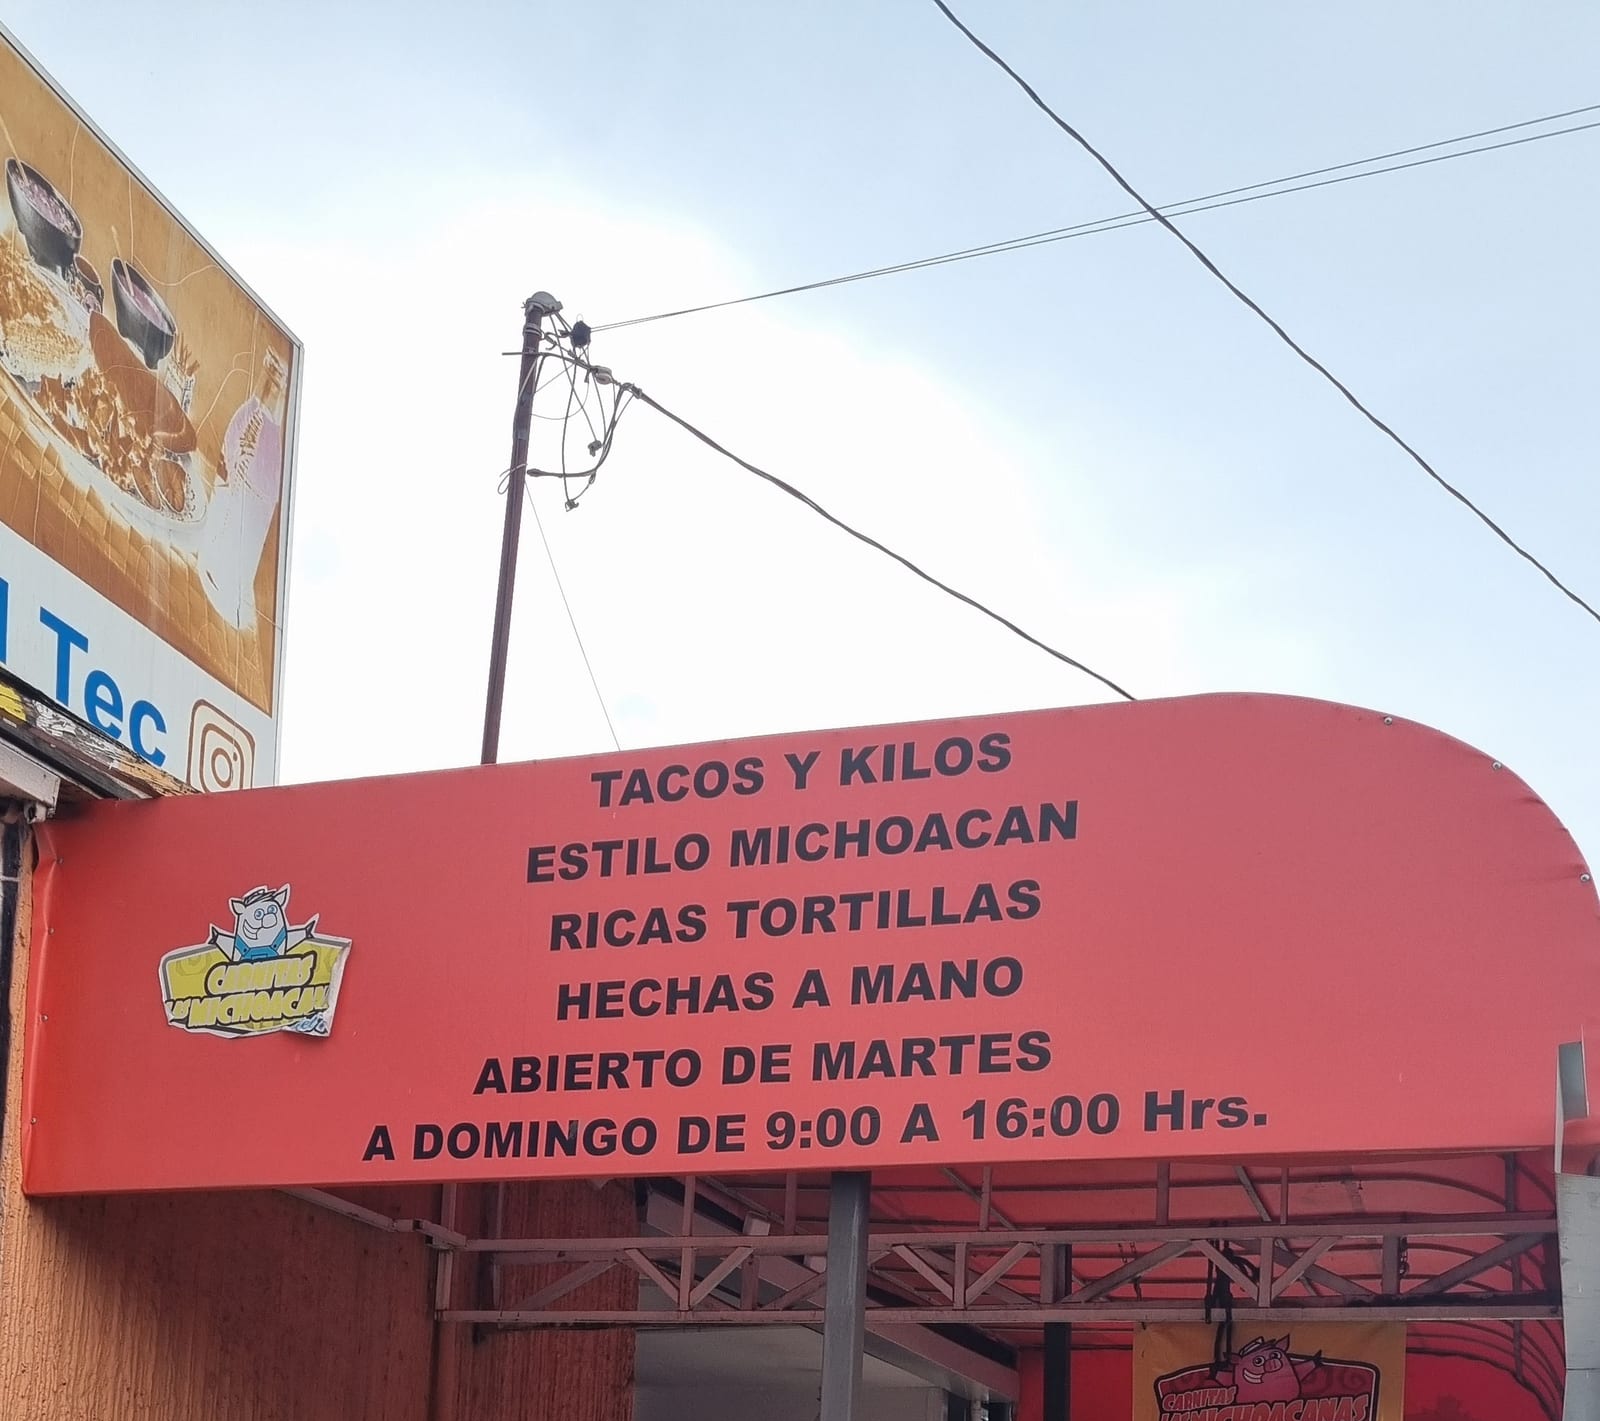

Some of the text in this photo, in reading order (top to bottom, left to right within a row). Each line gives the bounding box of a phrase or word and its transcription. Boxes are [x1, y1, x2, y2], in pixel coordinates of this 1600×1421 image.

[40, 606, 167, 767] Tec
[591, 733, 1011, 807] TACOS Y KILOS
[527, 800, 1079, 883] ESTILO MICHOACAN
[550, 879, 1041, 951] RICAS TORTILLAS
[557, 957, 1024, 1021] HECHAS A MANO
[473, 1031, 1051, 1095] ABIERTO DE MARTES
[362, 1090, 1267, 1161] A DOMINGO DE 9:00 A 16:00 Hrs.
[1161, 1386, 1237, 1412] CARNITAS
